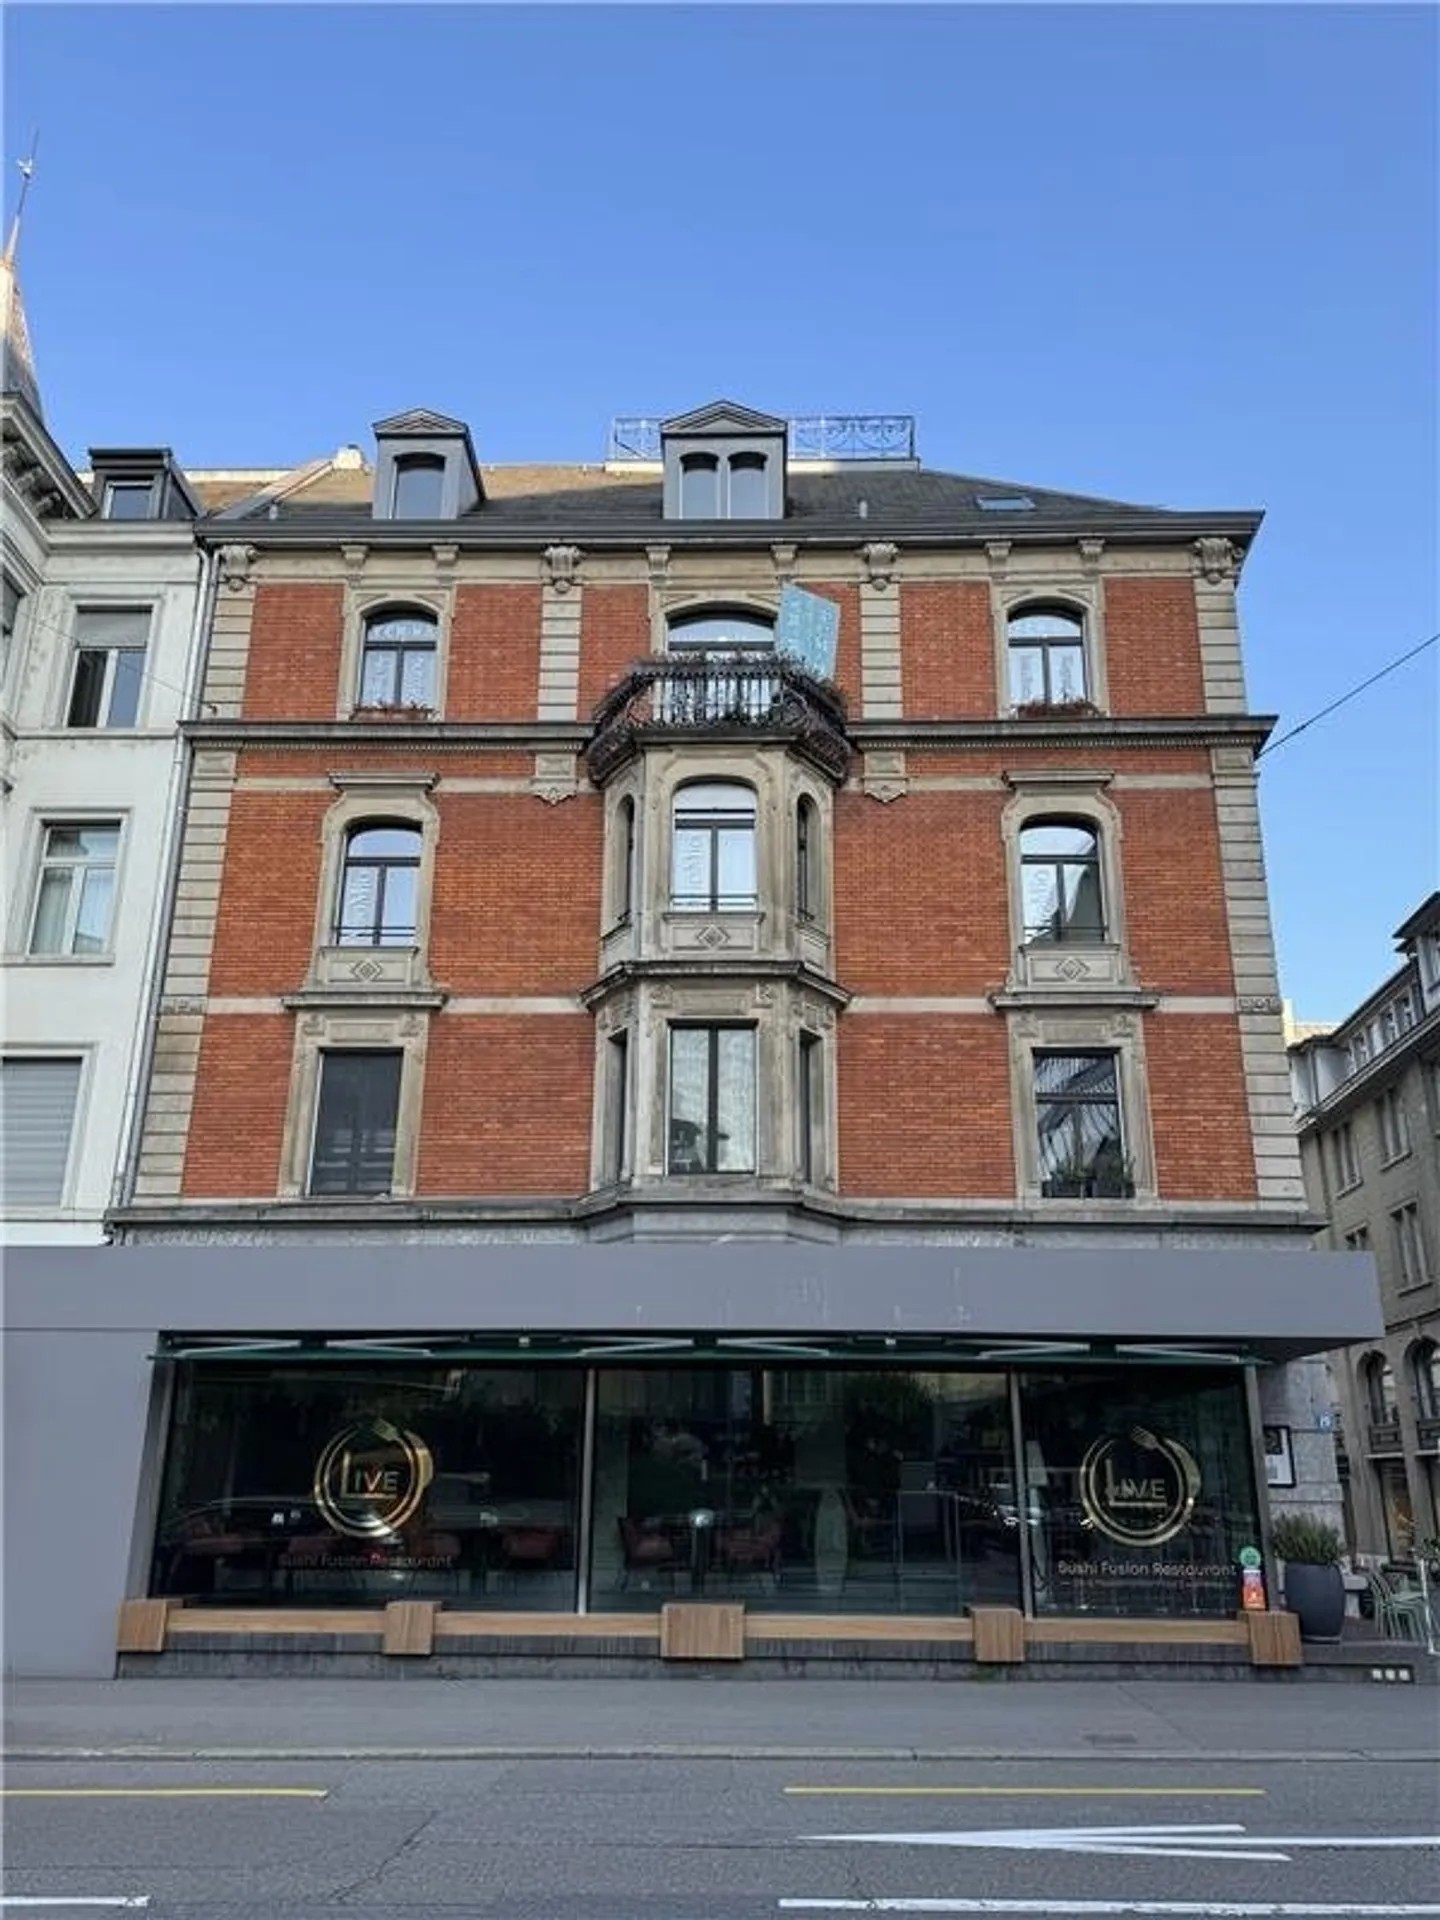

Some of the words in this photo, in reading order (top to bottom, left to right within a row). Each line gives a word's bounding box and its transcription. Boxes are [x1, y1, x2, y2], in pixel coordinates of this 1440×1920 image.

[340, 1450, 401, 1499] LIVE
[1104, 1457, 1168, 1508] LIVE
[1101, 1560, 1150, 1576] Fusion
[1152, 1561, 1237, 1577] Restaurant
